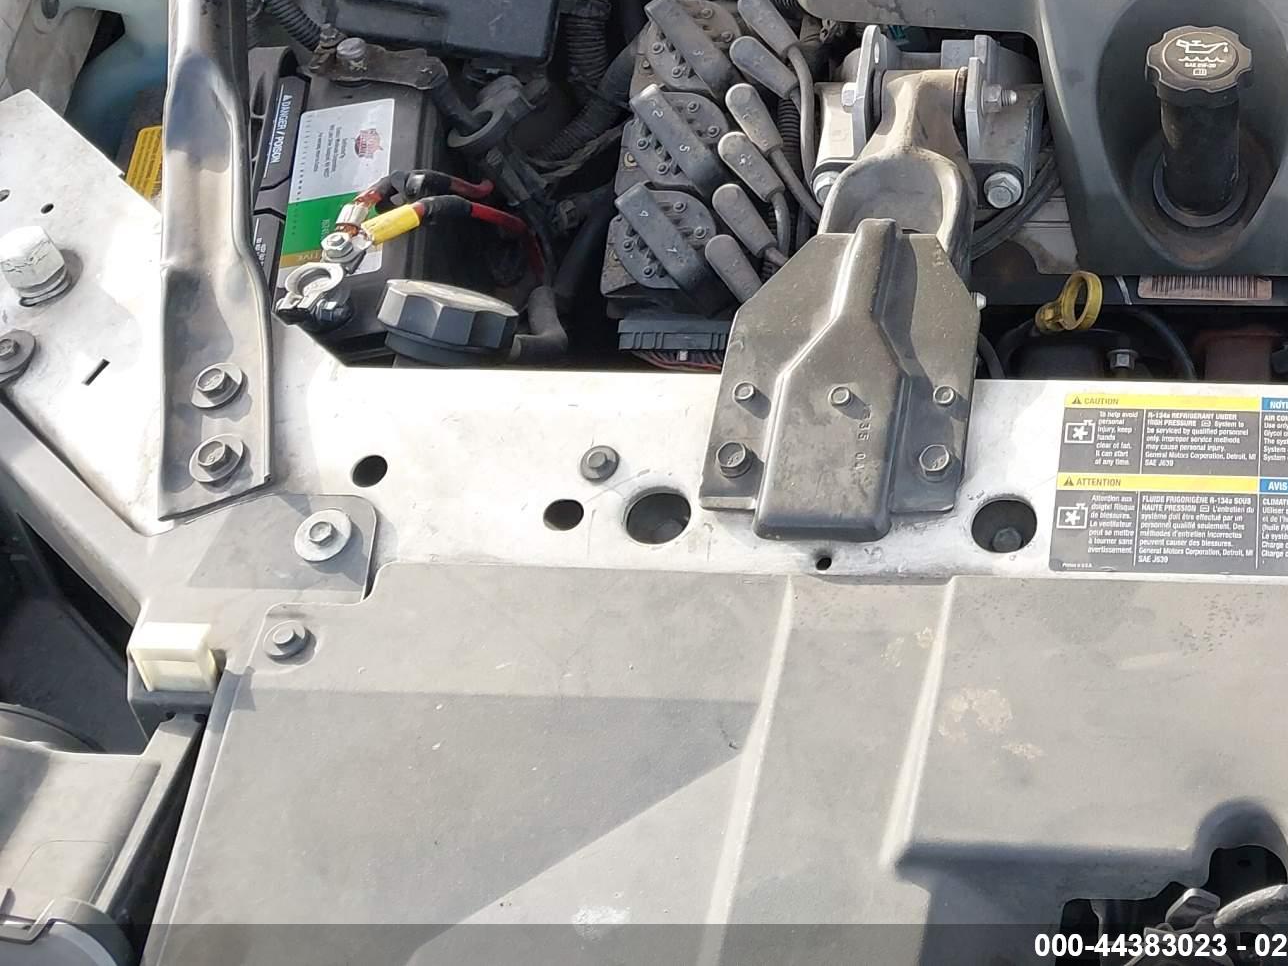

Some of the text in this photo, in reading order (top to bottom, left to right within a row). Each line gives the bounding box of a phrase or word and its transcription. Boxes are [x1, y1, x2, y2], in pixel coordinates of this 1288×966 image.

[270, 101, 289, 163] DANGER POISON
[1084, 397, 1119, 405] CAUTION
[1077, 478, 1121, 486] ATTENTION
[1268, 482, 1288, 490] AVIS
